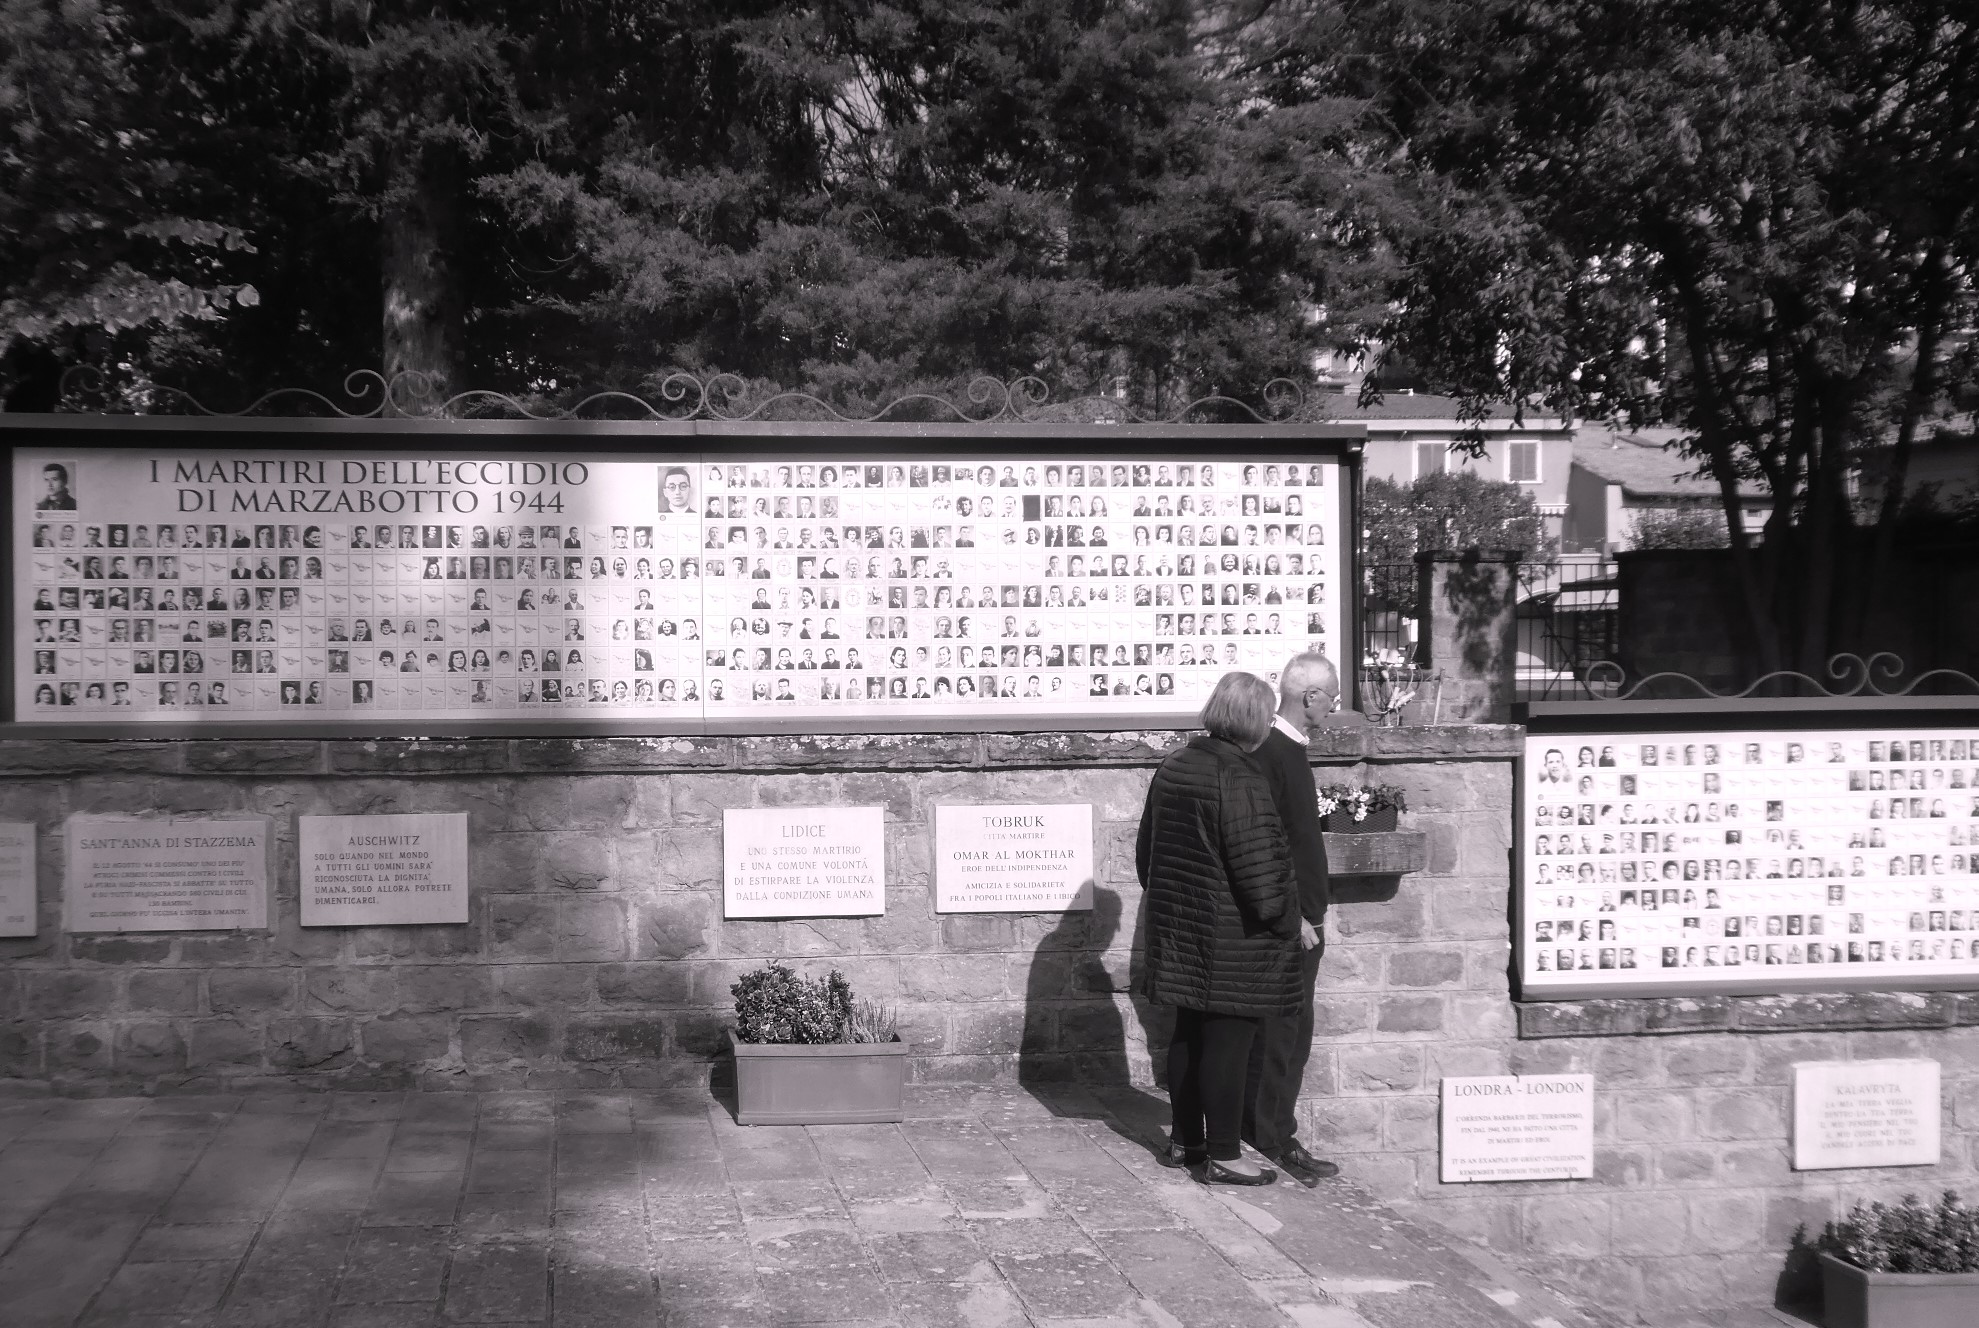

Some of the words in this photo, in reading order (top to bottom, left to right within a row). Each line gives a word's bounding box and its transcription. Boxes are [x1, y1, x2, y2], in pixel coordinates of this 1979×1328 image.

[150, 460, 159, 482] I
[173, 460, 325, 484] MARTIRI
[341, 460, 588, 485] DELL'ECCIDIO
[177, 489, 218, 512] DI
[230, 489, 478, 513] MARZABOTTO
[492, 490, 564, 513] 1944
[983, 816, 1045, 827] TOBRUK
[782, 825, 826, 838] LIDICE
[80, 838, 162, 850] SANT'ANNA
[166, 838, 179, 848] DI
[184, 837, 256, 848] STAZZEMA
[348, 836, 420, 846] AUSCHWITZ
[772, 847, 808, 855] STESSO
[813, 846, 861, 854] MARTIRIO
[954, 851, 989, 860] OMAR
[995, 851, 1010, 859] AL
[1015, 850, 1075, 859] MOKTHAR
[825, 876, 874, 884] VIOLENZA
[736, 892, 768, 900] DALLA
[774, 891, 831, 899] CONDIZIONE
[838, 890, 874, 899] UMANA
[1455, 1085, 1512, 1097] LONDRA
[1527, 1082, 1584, 1094] LONDON
